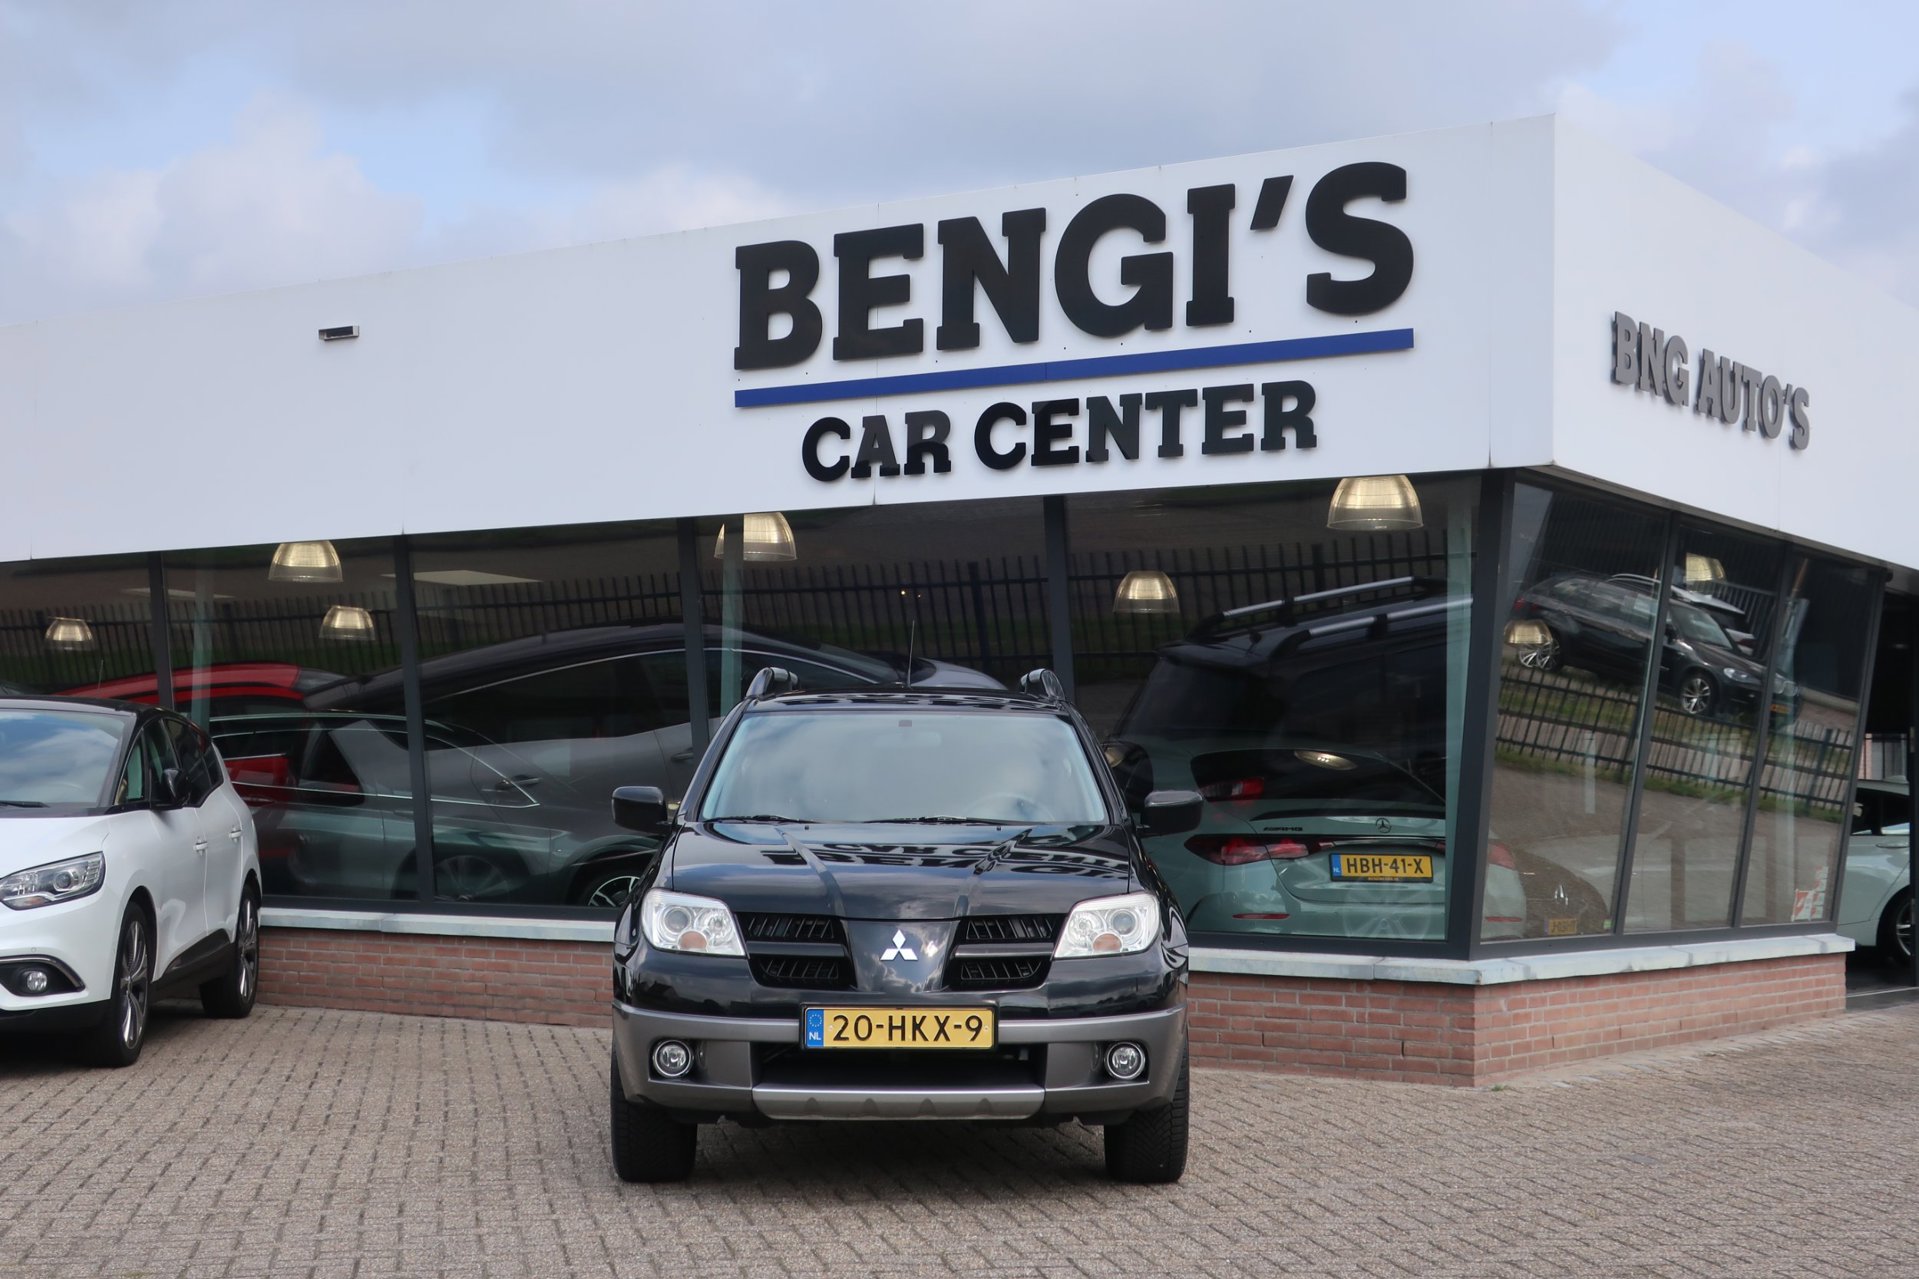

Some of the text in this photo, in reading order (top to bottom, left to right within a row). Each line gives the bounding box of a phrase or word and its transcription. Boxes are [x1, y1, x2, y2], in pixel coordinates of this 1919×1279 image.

[734, 161, 1414, 370] BENGI'S
[802, 380, 1317, 482] CAR CENTER
[1612, 311, 1810, 450] BNG AUTO'S
[1346, 857, 1424, 874] HBH-41-X
[809, 1014, 984, 1042] NL 20-HKX-9
